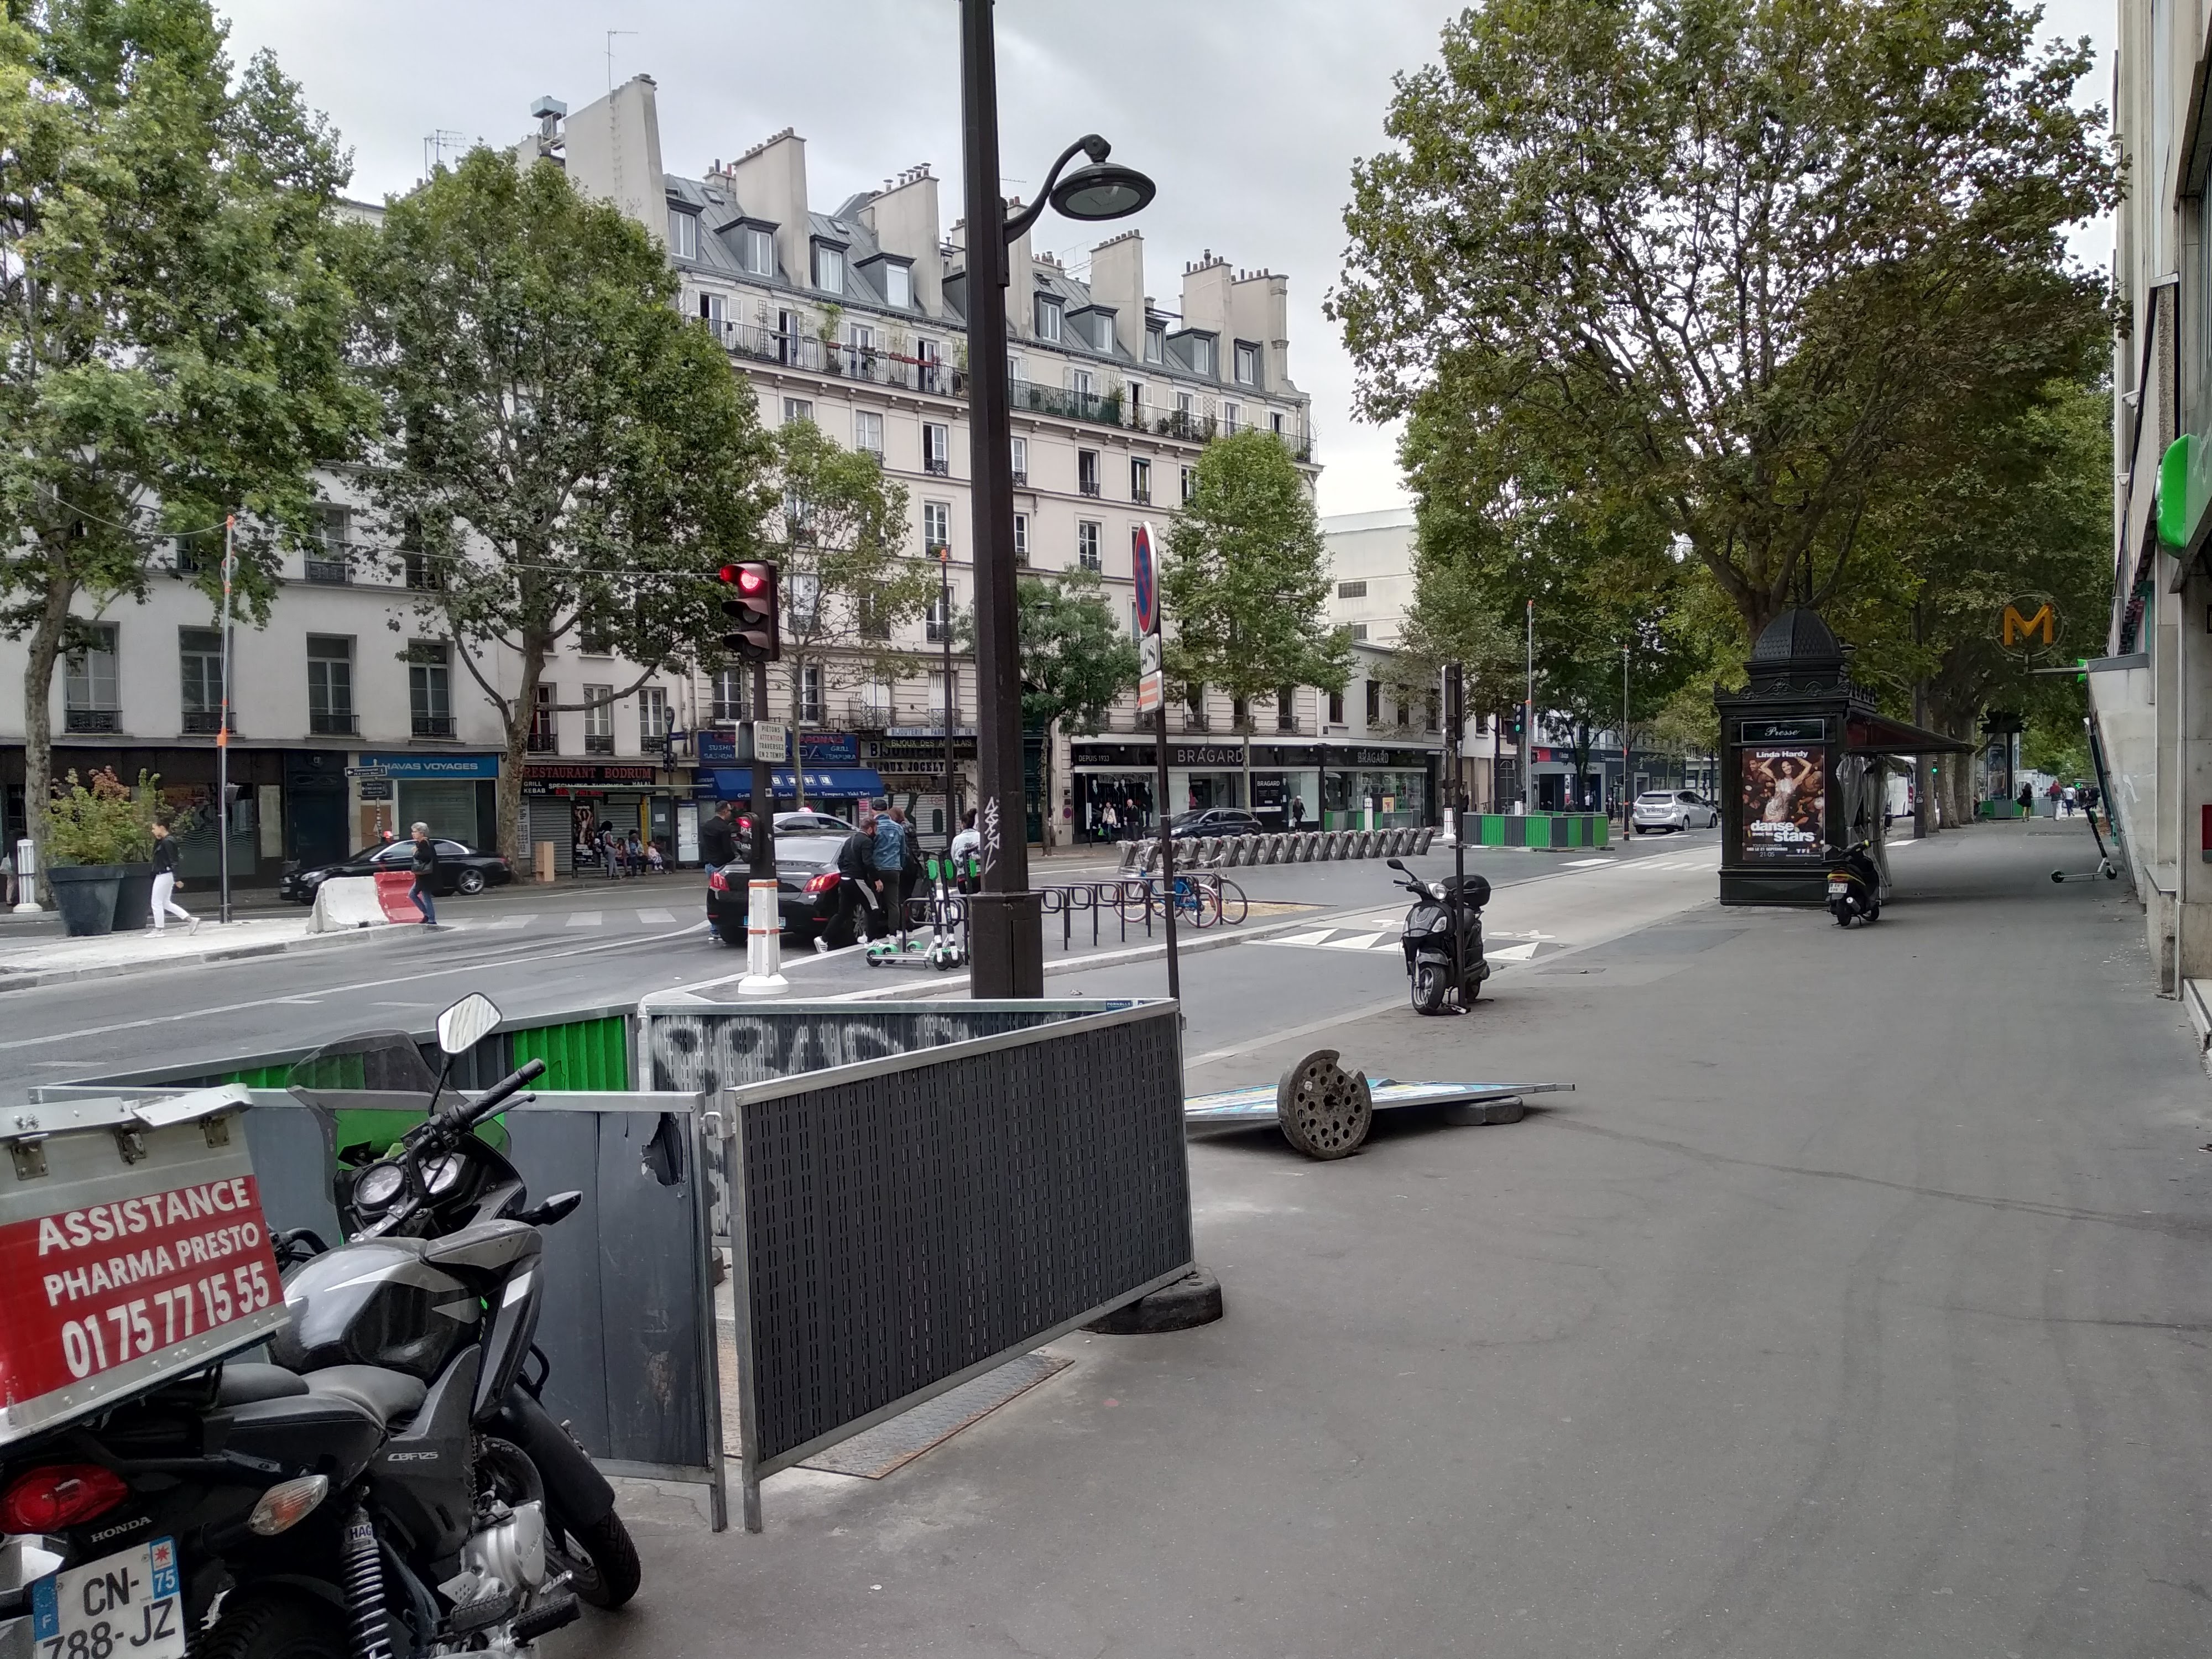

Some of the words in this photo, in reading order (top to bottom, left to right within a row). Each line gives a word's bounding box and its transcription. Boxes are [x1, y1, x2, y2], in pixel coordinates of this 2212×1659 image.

[2004, 605, 2052, 646] M
[1764, 726, 1801, 737] Presse
[759, 742, 784, 750] TRAVERSEZ
[1177, 750, 1244, 763] BRAGARD
[1357, 752, 1389, 764] BRAGARD
[523, 766, 596, 779] RESTAURANT
[604, 767, 651, 779] BODRUM
[907, 761, 958, 772] JOCELYE
[1750, 820, 1794, 831] danse
[1773, 830, 1815, 842] stars
[38, 1178, 251, 1256] ASSISTANCE
[43, 1245, 175, 1307] PHARMA
[175, 1222, 259, 1267] PRESTO
[61, 1314, 107, 1378] 01
[106, 1298, 154, 1361] 75
[154, 1283, 195, 1344] 77
[198, 1273, 232, 1327] 15
[233, 1261, 269, 1314] 55
[90, 1516, 153, 1543] HONDA
[154, 1568, 176, 1593] 75
[42, 1614, 51, 1629] F
